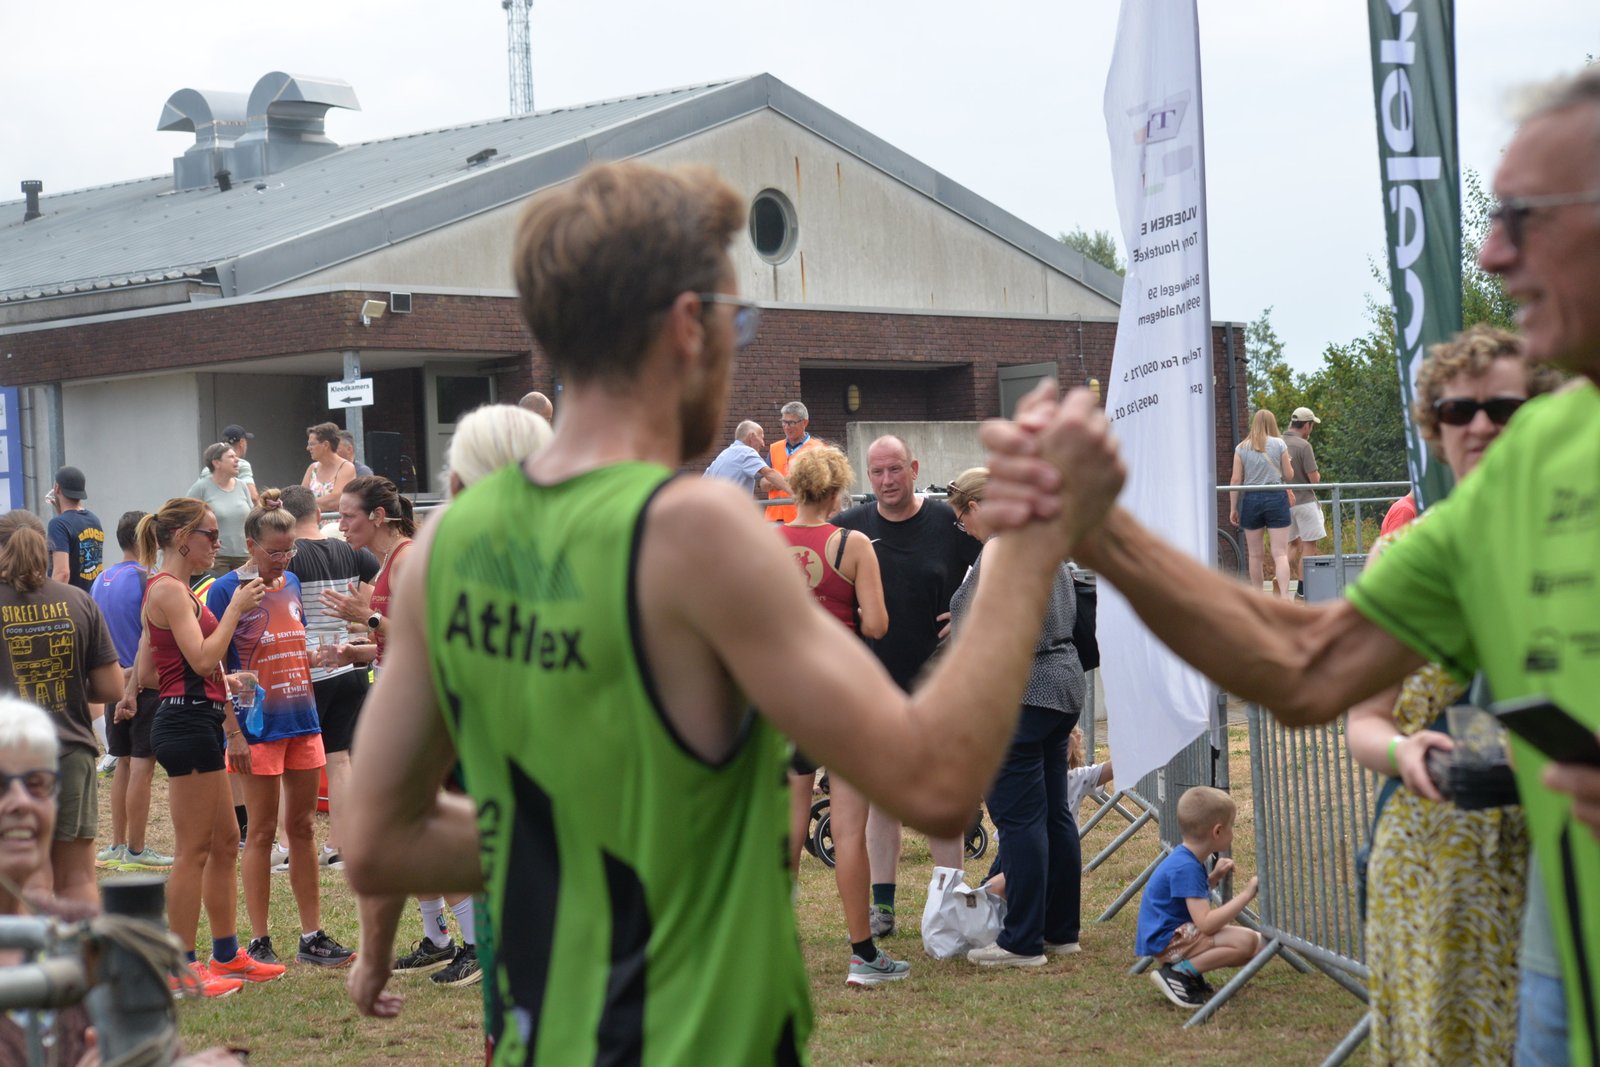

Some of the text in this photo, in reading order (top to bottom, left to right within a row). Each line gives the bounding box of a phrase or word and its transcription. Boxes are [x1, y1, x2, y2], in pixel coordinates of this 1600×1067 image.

[330, 384, 370, 392] Kleedkamers
[2, 601, 70, 622] STREET CAFE
[53, 623, 70, 631] CLUB
[169, 696, 185, 705] NIKE
